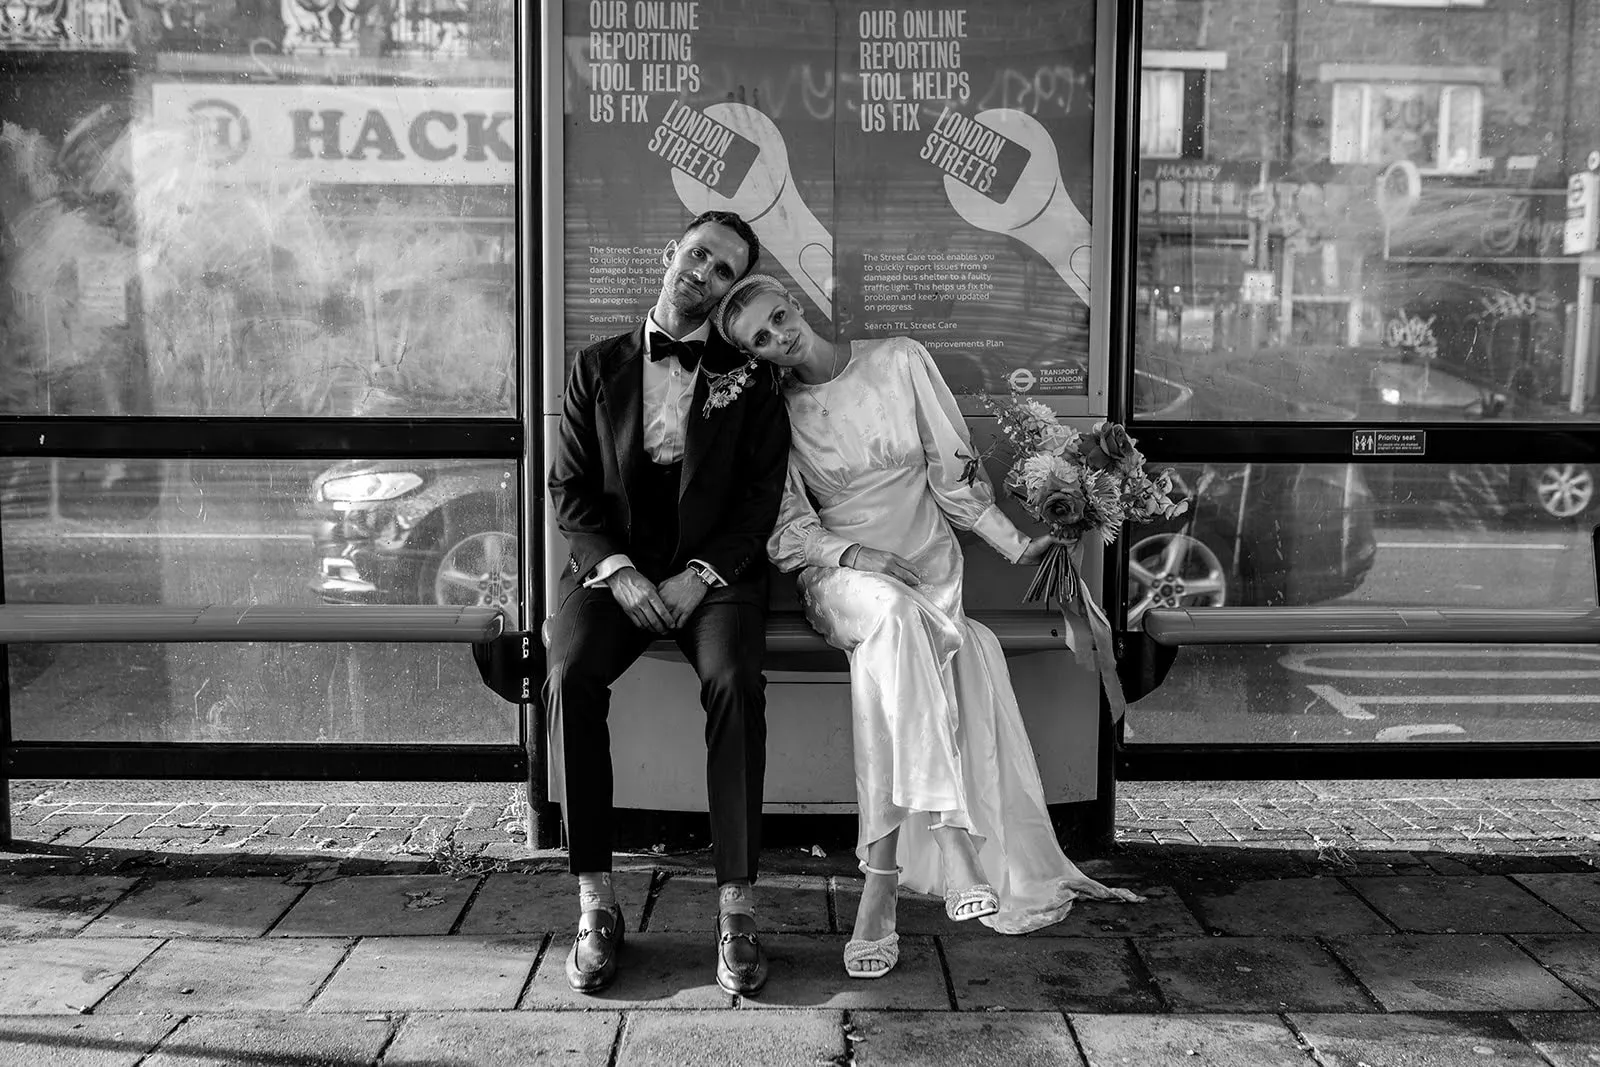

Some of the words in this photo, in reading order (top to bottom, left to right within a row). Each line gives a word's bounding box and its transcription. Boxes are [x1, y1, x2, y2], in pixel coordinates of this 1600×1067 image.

[590, 0, 627, 30] OUR
[635, 1, 699, 31] ONLINE
[859, 10, 896, 39] OUR
[903, 9, 967, 39] ONLINE
[590, 32, 691, 61] REPORTING
[860, 41, 961, 70] REPORTING
[589, 63, 635, 92] TOOL
[642, 64, 700, 93] HELPS
[860, 72, 906, 101] TOOL
[913, 71, 970, 101] HELPS
[589, 94, 614, 123] US
[621, 94, 648, 123] FIX
[860, 103, 885, 132] US
[892, 103, 920, 132] FIX
[661, 99, 735, 158] LONDON
[289, 109, 514, 162] HACK
[932, 106, 1006, 165] LONDON
[648, 124, 726, 187] STREETS
[920, 132, 997, 193] STREETS
[589, 246, 604, 254] The
[606, 246, 631, 254] Street
[601, 256, 630, 266] quickly
[632, 258, 658, 266] report
[864, 253, 878, 262] The
[880, 253, 906, 262] Street
[906, 253, 926, 261] Care
[928, 253, 944, 261] tool
[946, 252, 978, 261] enables
[980, 254, 995, 262] you
[590, 266, 627, 276] damaged
[875, 264, 904, 272] quickly
[906, 264, 932, 272] report
[960, 262, 981, 270] from
[590, 276, 615, 284] traffic
[640, 276, 656, 284] This
[864, 273, 901, 282] damaged
[920, 273, 948, 281] shelter
[968, 272, 992, 282] faulty
[590, 286, 625, 296] problem
[627, 286, 642, 294] and
[864, 284, 890, 292] traffic
[891, 284, 912, 292] light.
[932, 283, 955, 292] helps
[968, 282, 978, 290] fix
[602, 297, 639, 306] progress.
[864, 294, 899, 302] problem
[918, 294, 938, 302] keep
[940, 294, 954, 302] you
[956, 292, 990, 302] updated
[877, 304, 914, 313] progress.
[590, 314, 618, 323] Search
[620, 314, 634, 323] TfL
[864, 322, 892, 330] Search
[894, 322, 908, 330] TfL
[910, 322, 936, 330] Street
[938, 321, 958, 329] Care
[924, 340, 984, 350] Improvements
[986, 340, 1004, 348] Plan
[1378, 434, 1400, 442] Priority
